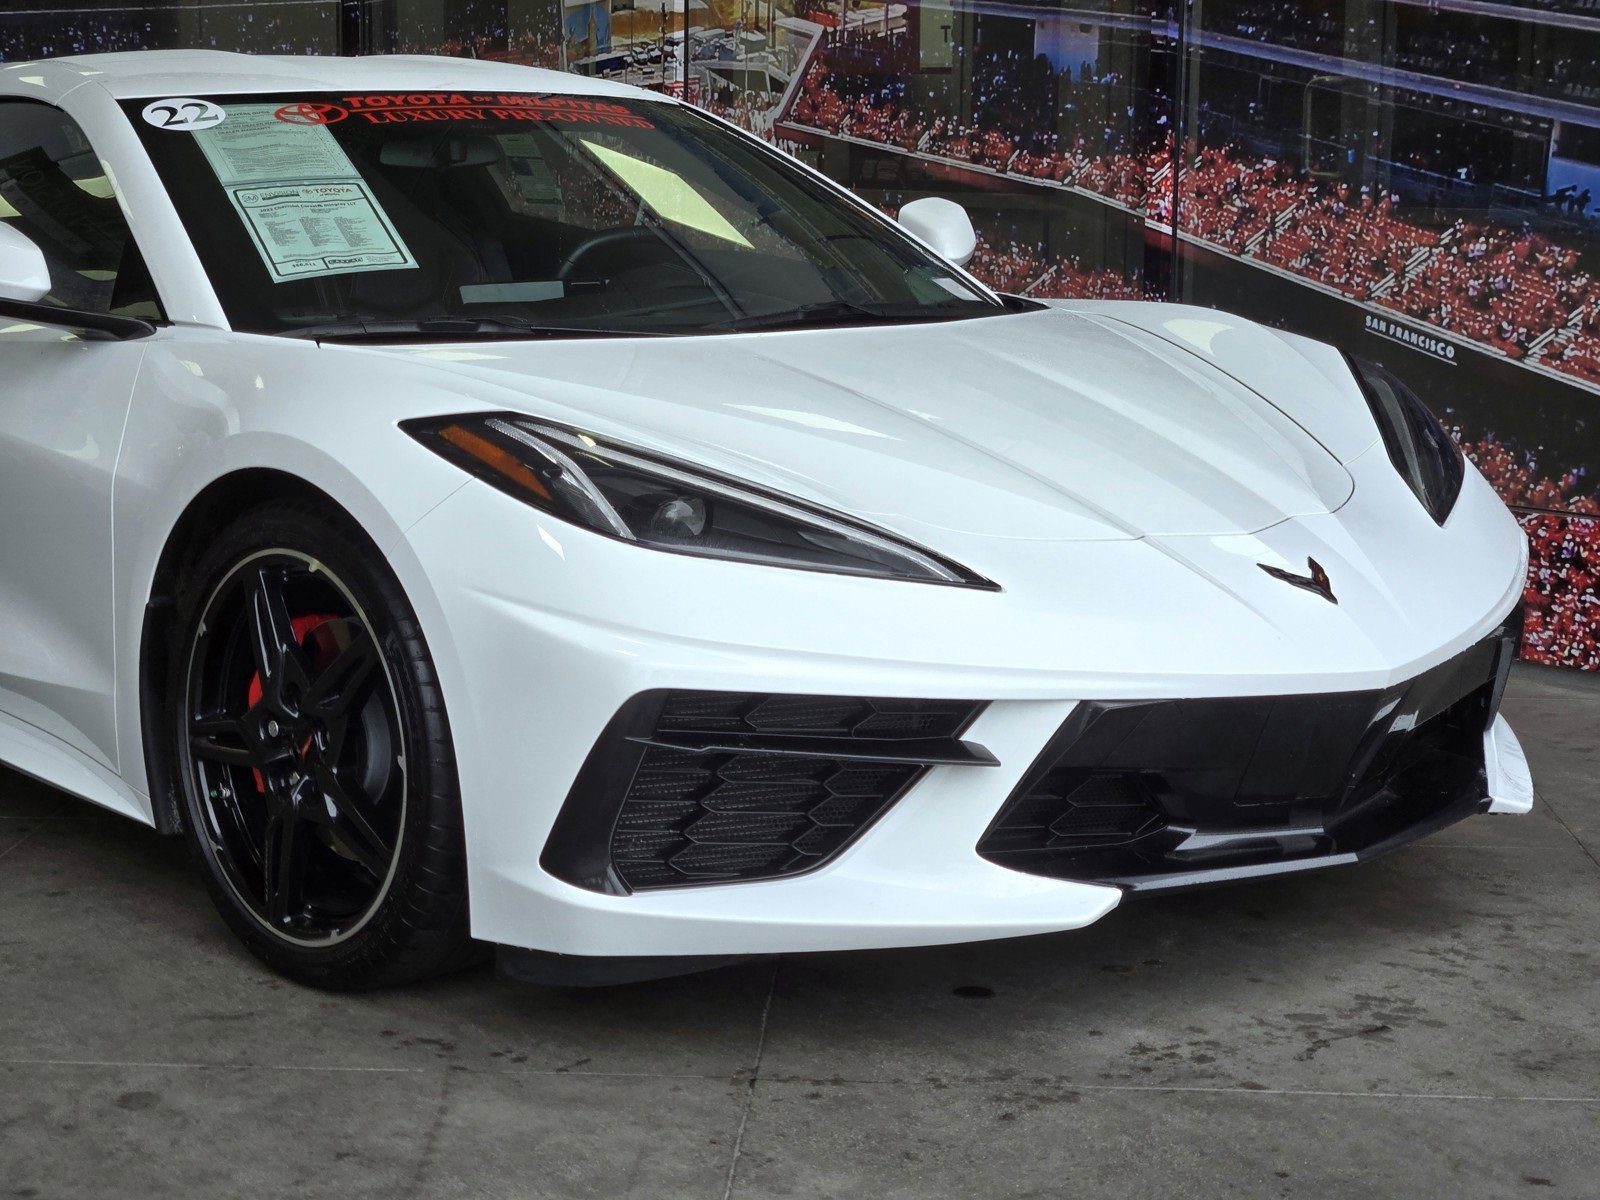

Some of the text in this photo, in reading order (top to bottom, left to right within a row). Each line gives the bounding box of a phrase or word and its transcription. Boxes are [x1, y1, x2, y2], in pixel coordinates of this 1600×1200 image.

[150, 102, 219, 127] 22
[342, 94, 472, 108] TOYOTA
[496, 94, 632, 115] MILPITAS
[360, 109, 657, 130] LUXURY PRE-OWNED
[259, 189, 300, 198] ENVISION
[312, 186, 353, 194] TOYOTA
[1365, 315, 1455, 358] SAN FRANCISCO
